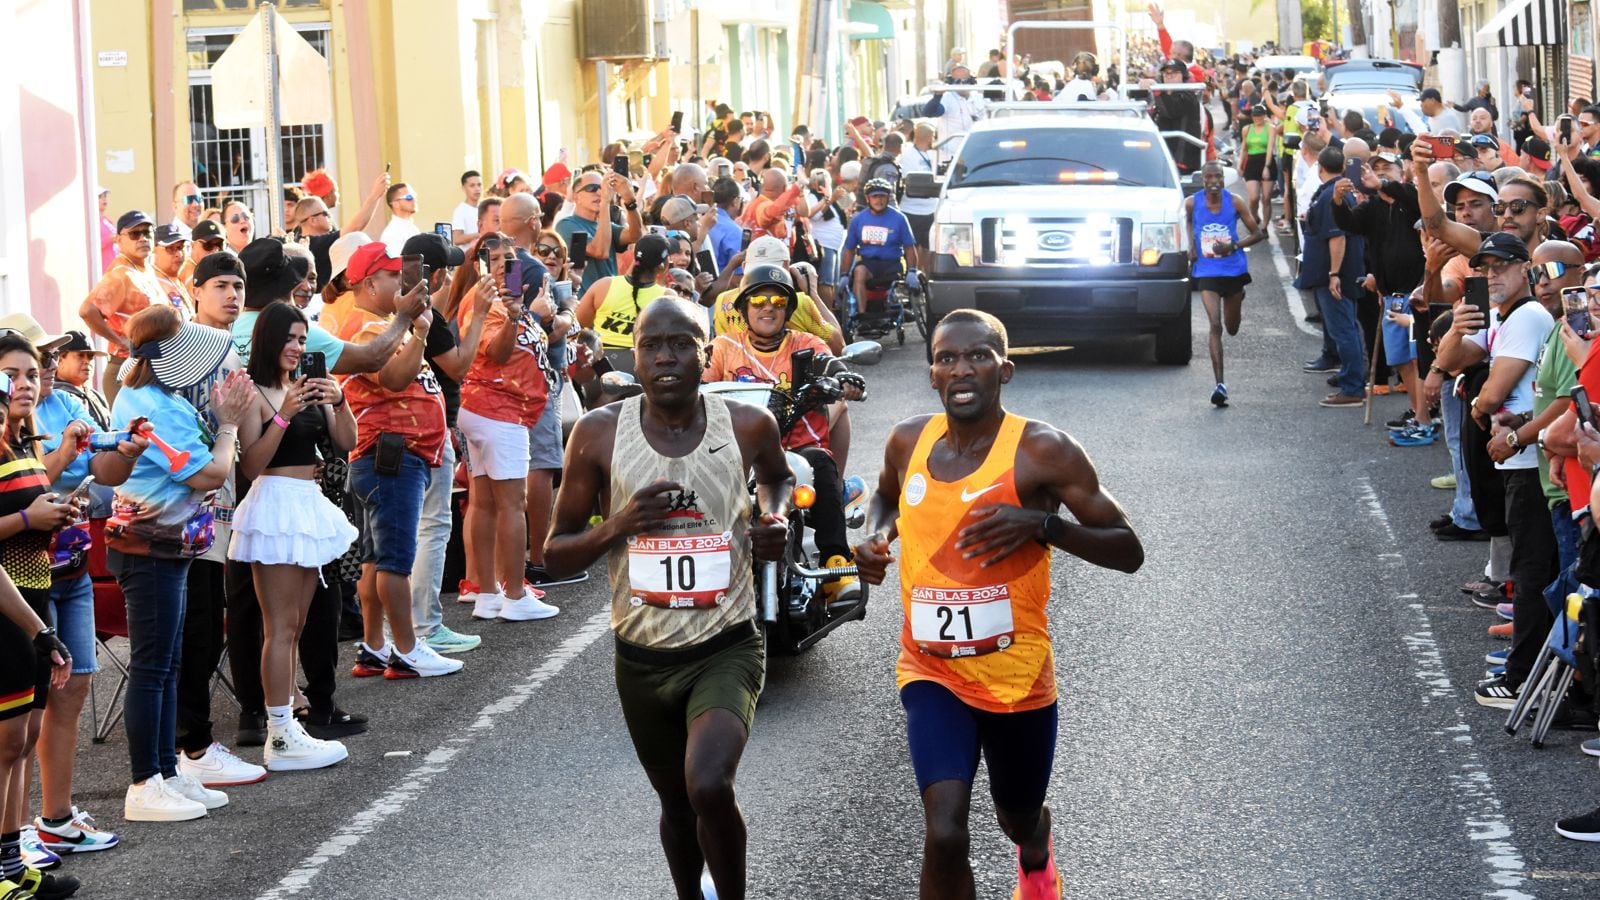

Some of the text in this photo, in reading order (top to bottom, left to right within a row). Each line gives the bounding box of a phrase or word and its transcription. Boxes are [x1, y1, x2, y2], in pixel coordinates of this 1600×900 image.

[662, 519, 717, 531] ational Elite T.C.
[631, 537, 730, 550] SAN BLAS 2024
[660, 555, 696, 591] 10
[912, 586, 1009, 601] SAN BLAS 2024
[937, 606, 976, 641] 21
